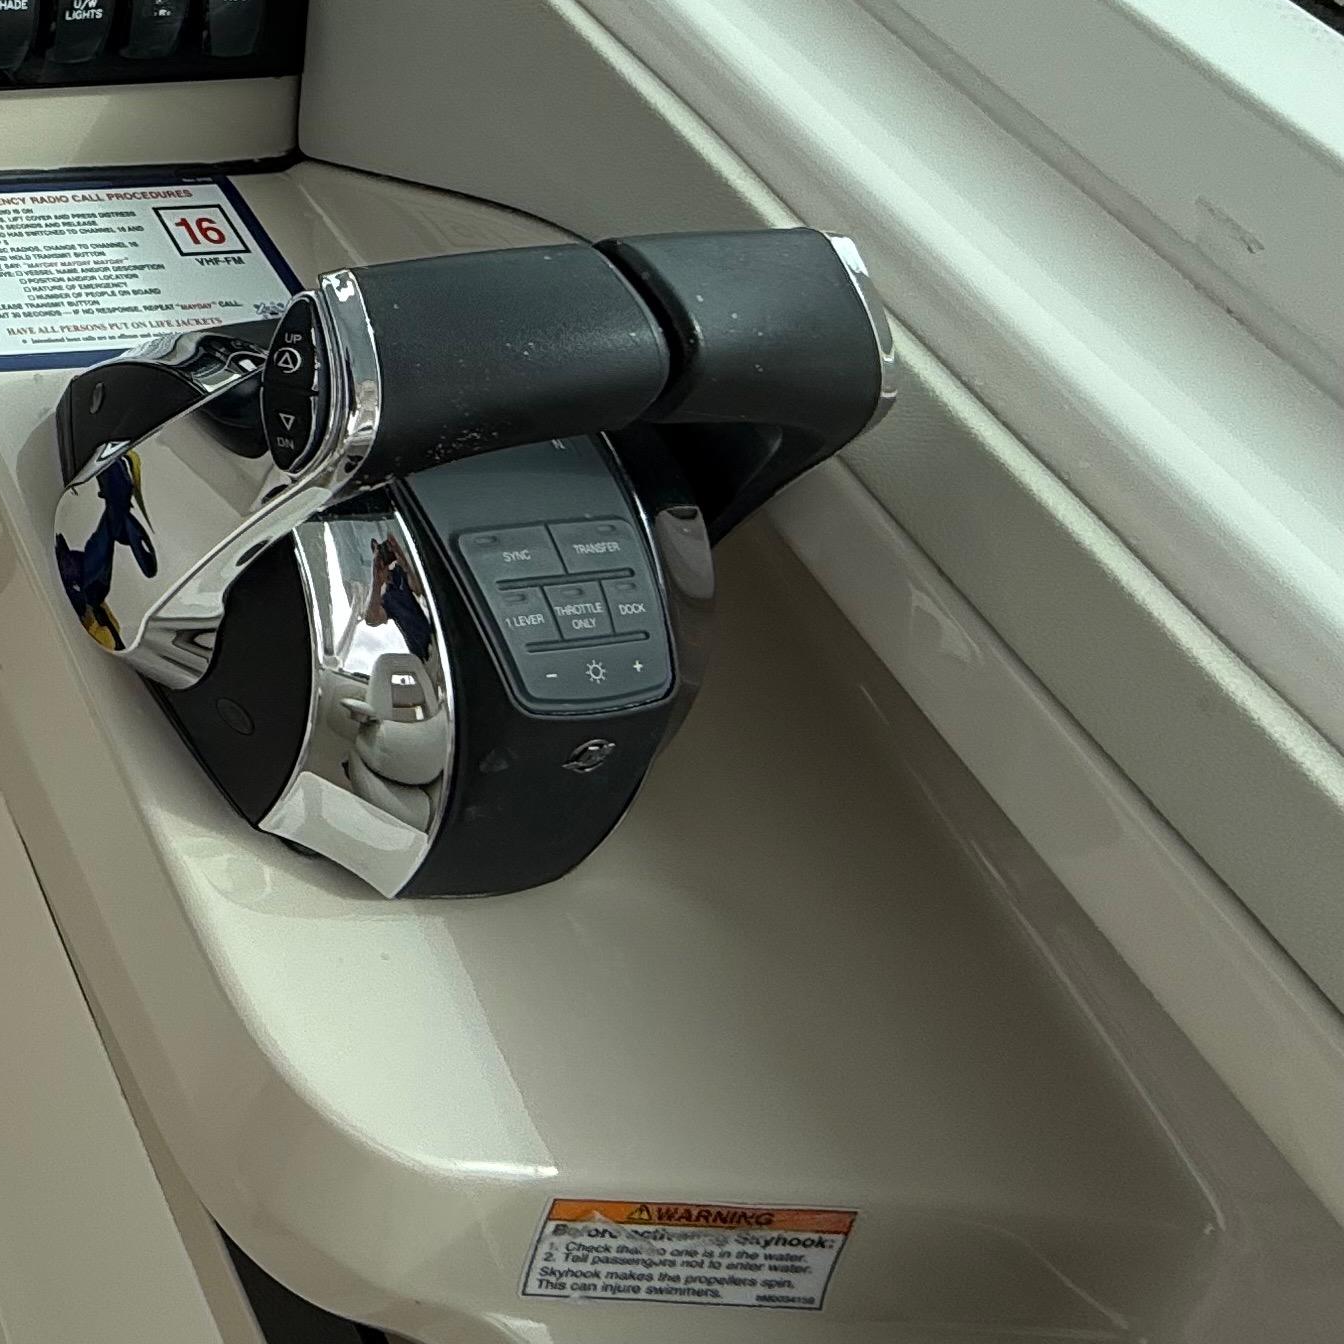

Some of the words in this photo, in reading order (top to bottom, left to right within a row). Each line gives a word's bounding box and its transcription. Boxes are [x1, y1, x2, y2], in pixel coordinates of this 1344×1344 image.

[65, 8, 103, 20] LIGHTS
[30, 195, 70, 204] RADIO
[72, 194, 104, 202] CALL
[106, 190, 193, 201] PROCEDURES
[175, 218, 226, 244] 16
[195, 256, 245, 266] VHF-FM
[6, 327, 36, 336] HAVE
[38, 326, 59, 334] ALL
[60, 324, 108, 332] PERSONS
[108, 322, 132, 330] PUT
[132, 321, 148, 330] ON
[149, 320, 172, 328] LIFE
[175, 318, 223, 328] JACKETS
[284, 332, 302, 344] UP
[276, 436, 294, 450] DN
[572, 542, 621, 554] TRANSFER
[502, 550, 532, 562] SYNC
[555, 602, 603, 616] THROTTLE
[618, 603, 646, 614] DOCK
[514, 614, 545, 626] LEVER
[572, 617, 597, 630] ONLY
[656, 1207, 775, 1226] WARNING
[566, 1241, 612, 1254] Check
[735, 1250, 759, 1260] the
[564, 1252, 588, 1262] Tell
[590, 1256, 676, 1268] passengers
[680, 1258, 704, 1268] not
[708, 1260, 722, 1270] to
[726, 1261, 766, 1272] enter
[539, 1266, 600, 1279] Skyhook
[604, 1270, 653, 1282] makes
[658, 1272, 680, 1282] the
[684, 1274, 758, 1287] propellers
[538, 1278, 566, 1290] This
[570, 1282, 597, 1292] can
[601, 1282, 641, 1294] injure
